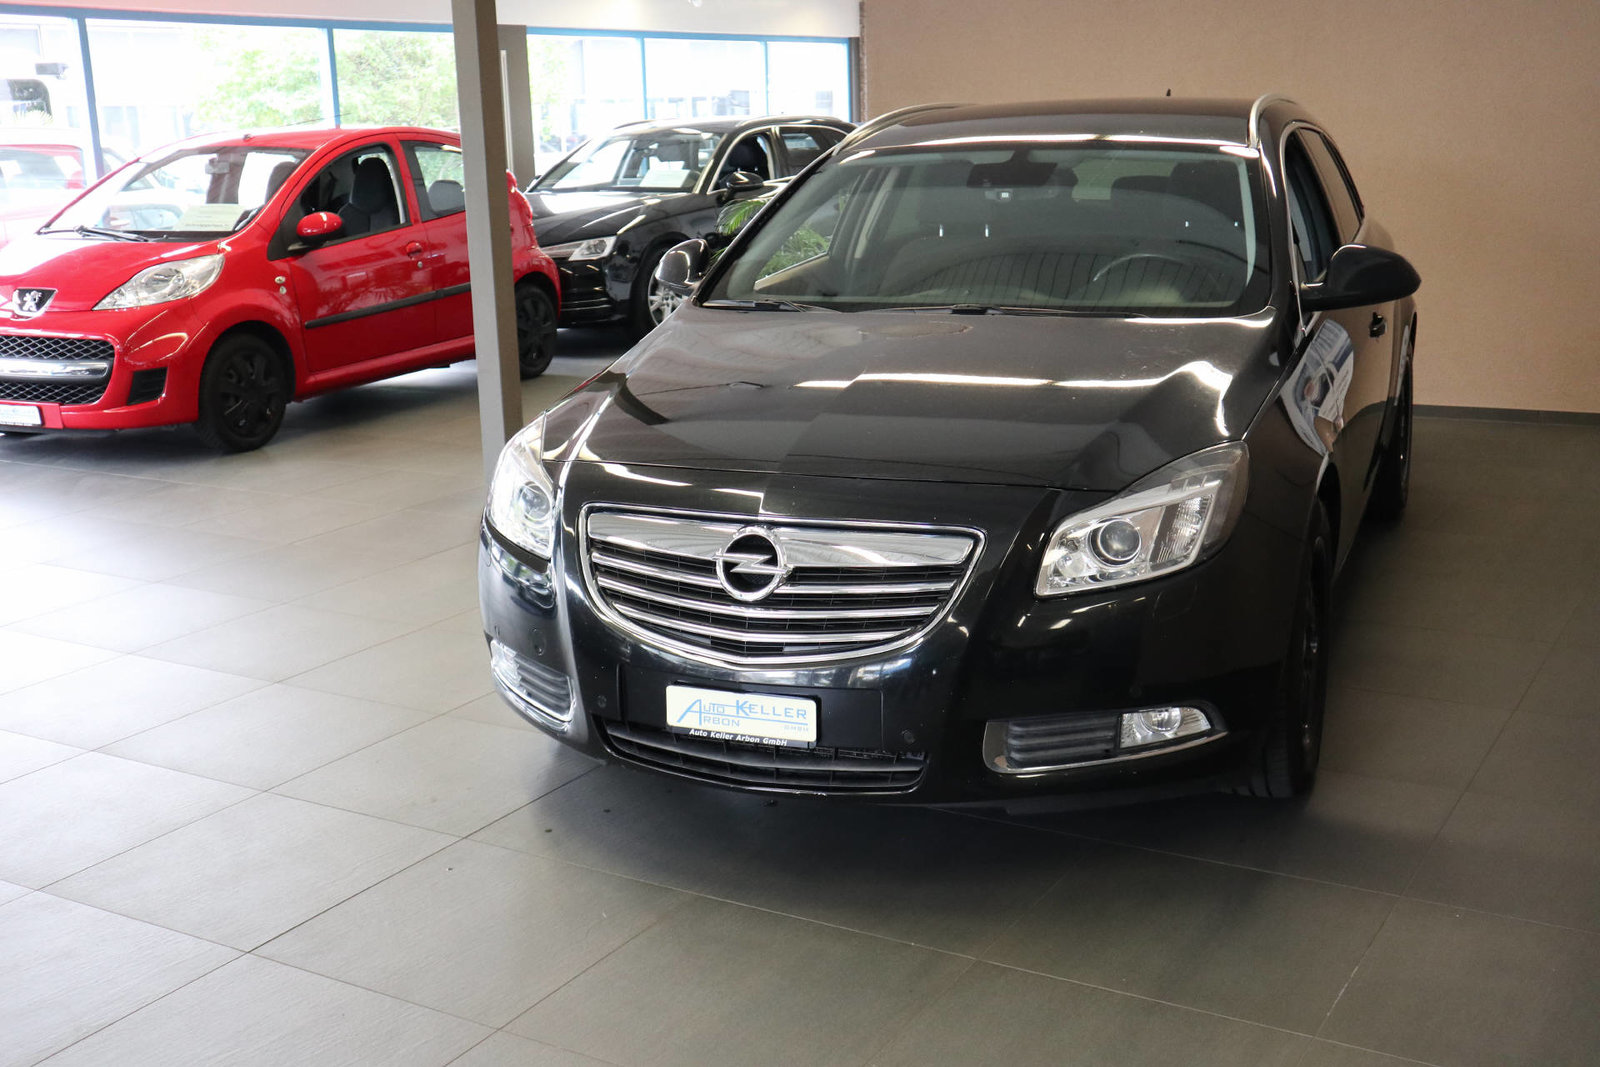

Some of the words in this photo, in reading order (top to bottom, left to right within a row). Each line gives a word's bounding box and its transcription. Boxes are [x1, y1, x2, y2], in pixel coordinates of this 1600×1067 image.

[736, 699, 807, 720] KELLER
[689, 728, 708, 737] Auto
[710, 731, 734, 741] Keller
[735, 734, 759, 744] Arbon
[762, 737, 787, 747] GmbH
